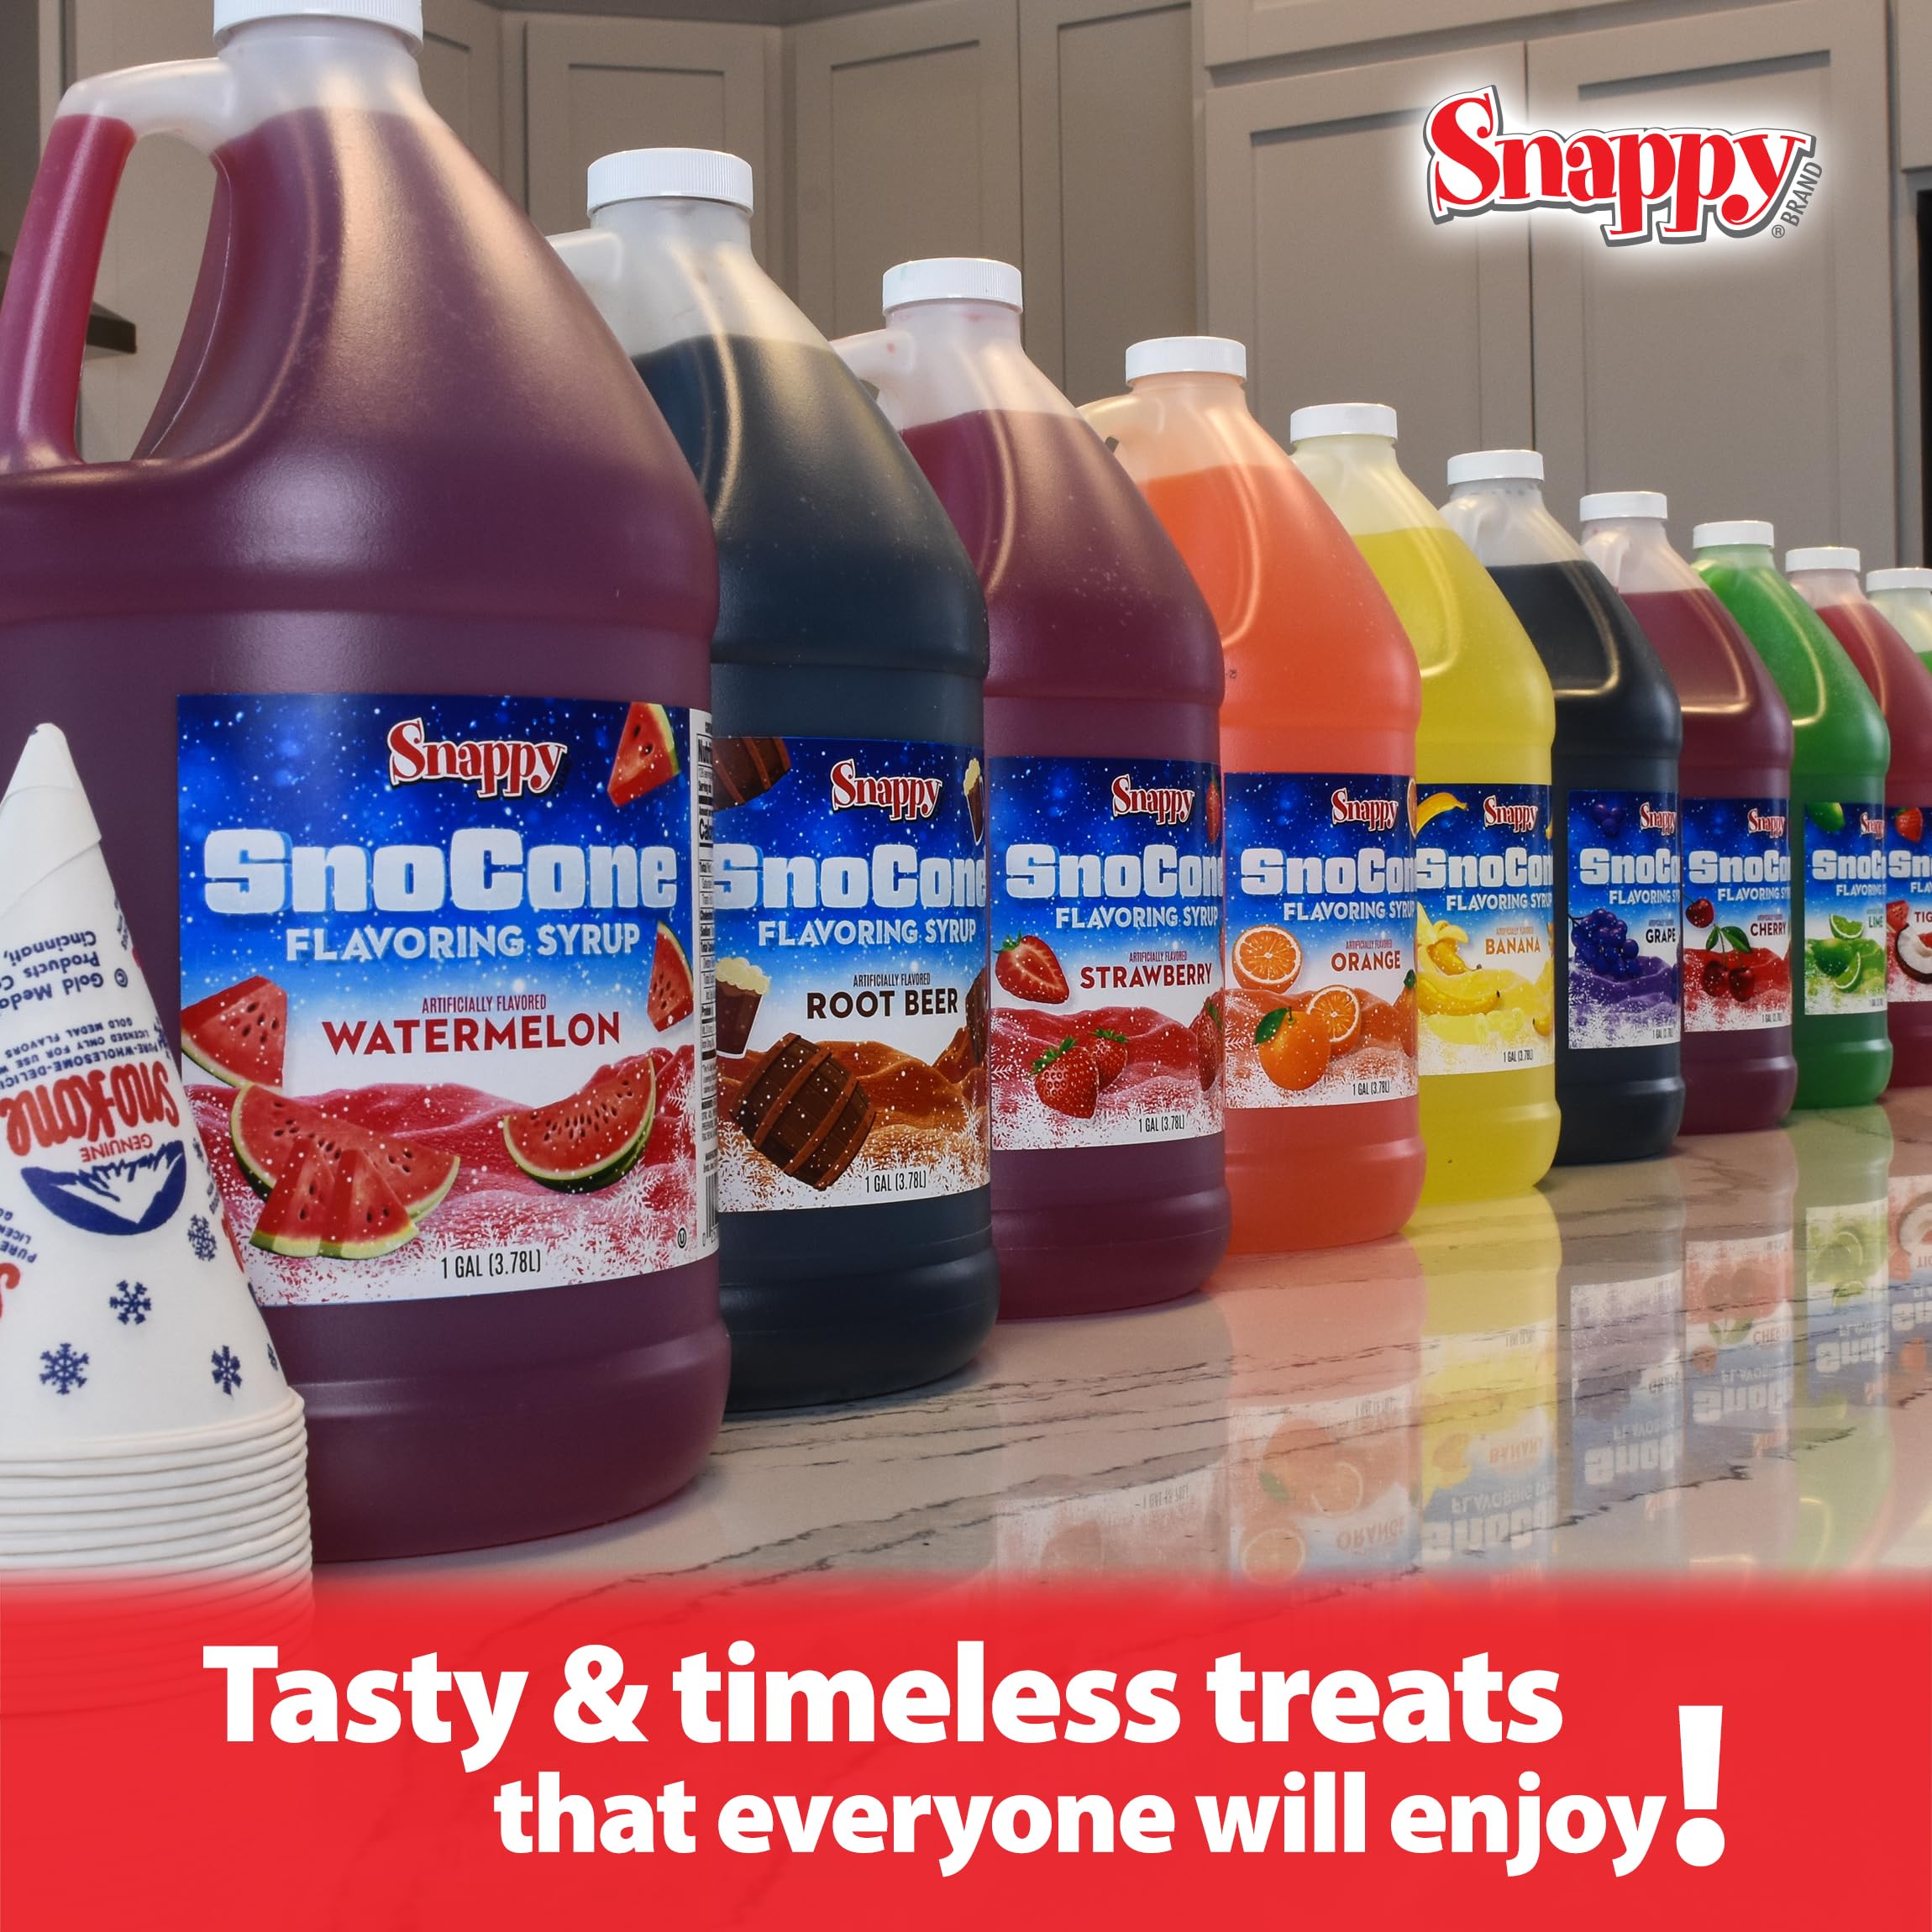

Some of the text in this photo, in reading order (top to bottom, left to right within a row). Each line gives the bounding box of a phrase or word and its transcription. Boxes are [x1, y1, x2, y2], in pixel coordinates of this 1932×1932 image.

[387, 717, 567, 796] Snappy
[830, 759, 942, 820] Snappy
[1110, 774, 1194, 824] Snappy
[1331, 788, 1398, 831] Snappy
[1483, 795, 1537, 833] Snappy
[1640, 802, 1677, 836] Snappy
[1748, 808, 1785, 838] Snappy
[204, 827, 678, 914] SnoCone
[712, 843, 986, 909] SnoCone
[1241, 848, 1417, 895] SnoCon
[1416, 847, 1553, 889] SnoCon
[1888, 850, 1932, 878] Sn
[1446, 892, 1552, 911] FLAVORING SYRUP
[1609, 889, 1671, 905] FLAVORING
[1718, 887, 1780, 901] FLAVORING
[1056, 906, 1218, 929] FLAVORING SYRUP
[1284, 900, 1415, 921] FLAVORING SYRUP
[1868, 916, 1883, 928] LIME
[286, 921, 641, 962] FLAVORING SYRUP
[758, 918, 976, 948] FLAVORING SYRUP
[1646, 928, 1675, 943] GRAPE
[1751, 922, 1786, 936] CHERRY
[3, 931, 97, 966] Cincinnati,
[1129, 950, 1188, 963] ARTIFICIALLY FLAVORED
[1485, 937, 1541, 955] BANANA
[0, 951, 100, 990] Products C
[1331, 950, 1401, 971] ORANGE
[62, 973, 104, 995] Gold
[853, 972, 931, 988] ARTIFICIALLY FLAVORED
[1080, 963, 1212, 989] STRAWBERRY
[422, 993, 547, 1015] ARTIFICIALLY FLAVORED
[806, 986, 958, 1020] ROOT BEER
[5, 1017, 133, 1059] GOLD MEDAL FLAVORS
[77, 1037, 105, 1050] ONLY
[111, 1030, 150, 1042] LICENSED
[322, 1011, 621, 1056] WATERMELON
[16, 1055, 39, 1068] USE
[45, 1046, 71, 1058] FOR
[1508, 1051, 1517, 1063] GAL
[1352, 1084, 1356, 1096] 1
[1358, 1083, 1369, 1095] GAL
[1138, 1113, 1185, 1133] 1 GAL (3.78L)
[79, 1133, 153, 1163] GENUINE
[865, 1168, 927, 1194] 1 GAL (3.78L)
[440, 1249, 542, 1279] 1 GAL (3.78L)
